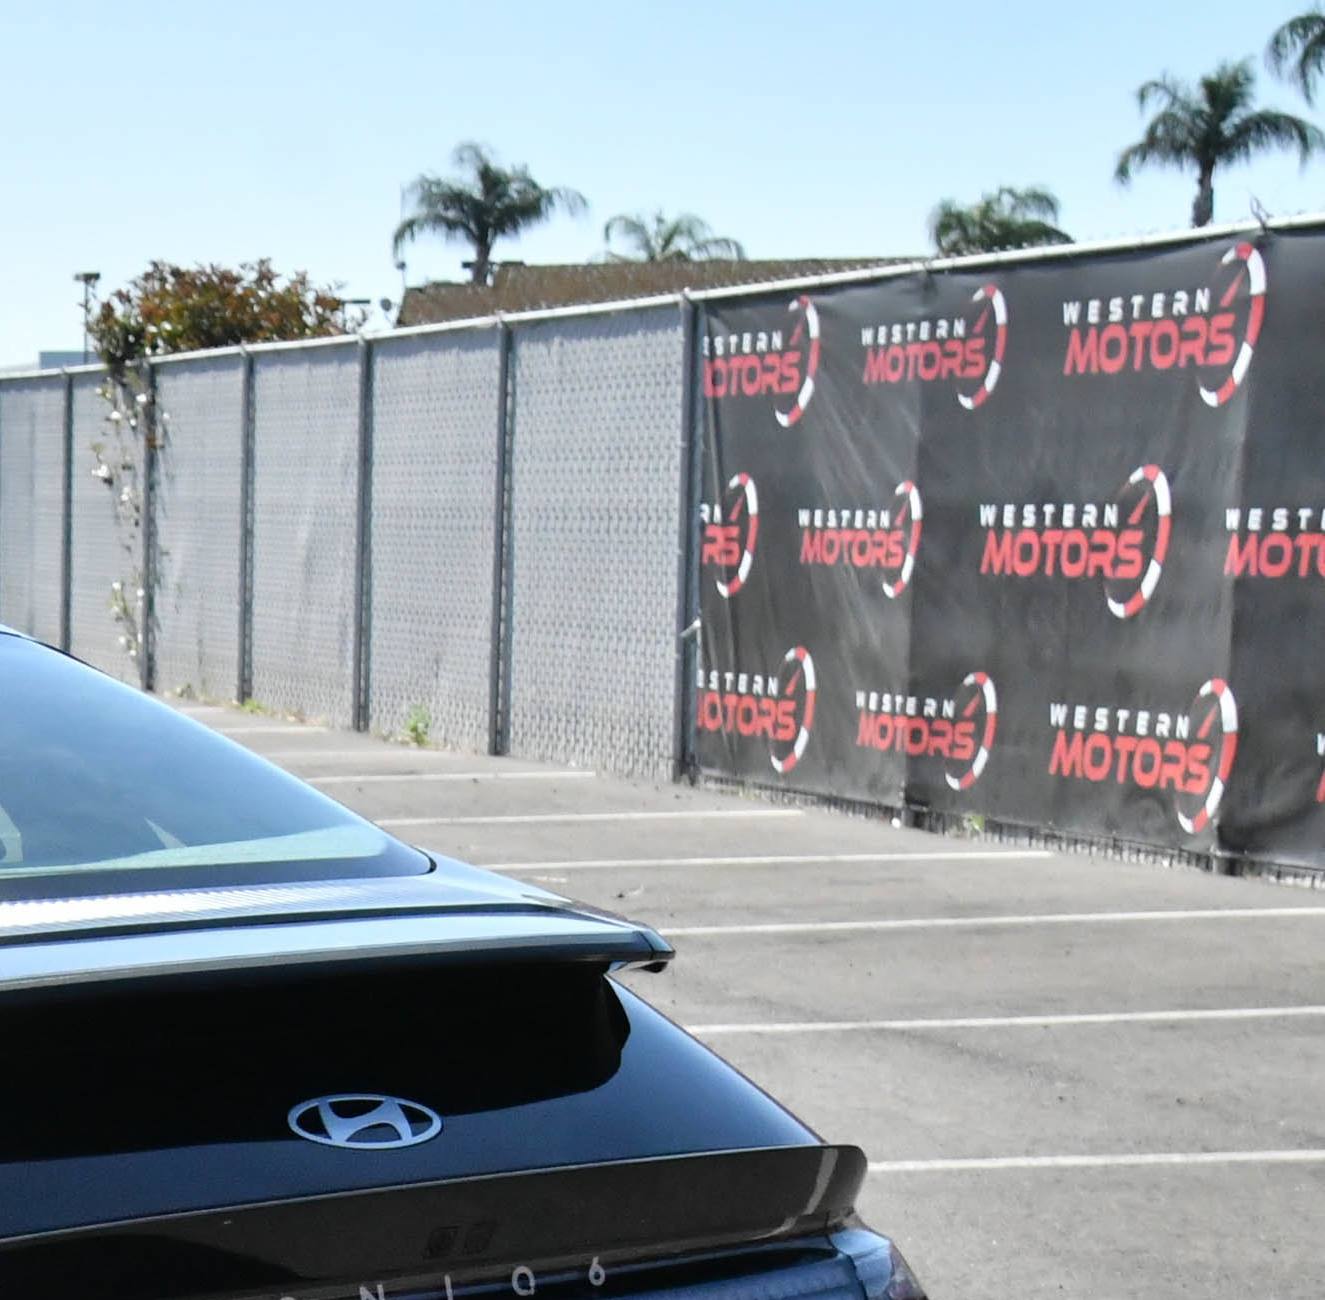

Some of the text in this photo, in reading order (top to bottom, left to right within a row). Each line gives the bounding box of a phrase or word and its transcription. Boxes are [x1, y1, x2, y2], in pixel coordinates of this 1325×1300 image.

[1064, 288, 1210, 324] WESTERN
[862, 319, 964, 345] WESTERN
[1065, 313, 1235, 374] MOTORS
[865, 338, 986, 382] MOTORS
[799, 509, 890, 529] WESTERN
[980, 504, 1117, 527] WESTERN
[802, 530, 904, 568] MOTORS
[981, 529, 1143, 578] MOTORS
[1225, 533, 1325, 576] MOT
[698, 688, 797, 740] OTORS
[856, 690, 954, 720] WESTERN
[1051, 703, 1190, 739] WESTERN
[858, 709, 975, 759] MOTORS
[1050, 728, 1211, 794] MOTORS
